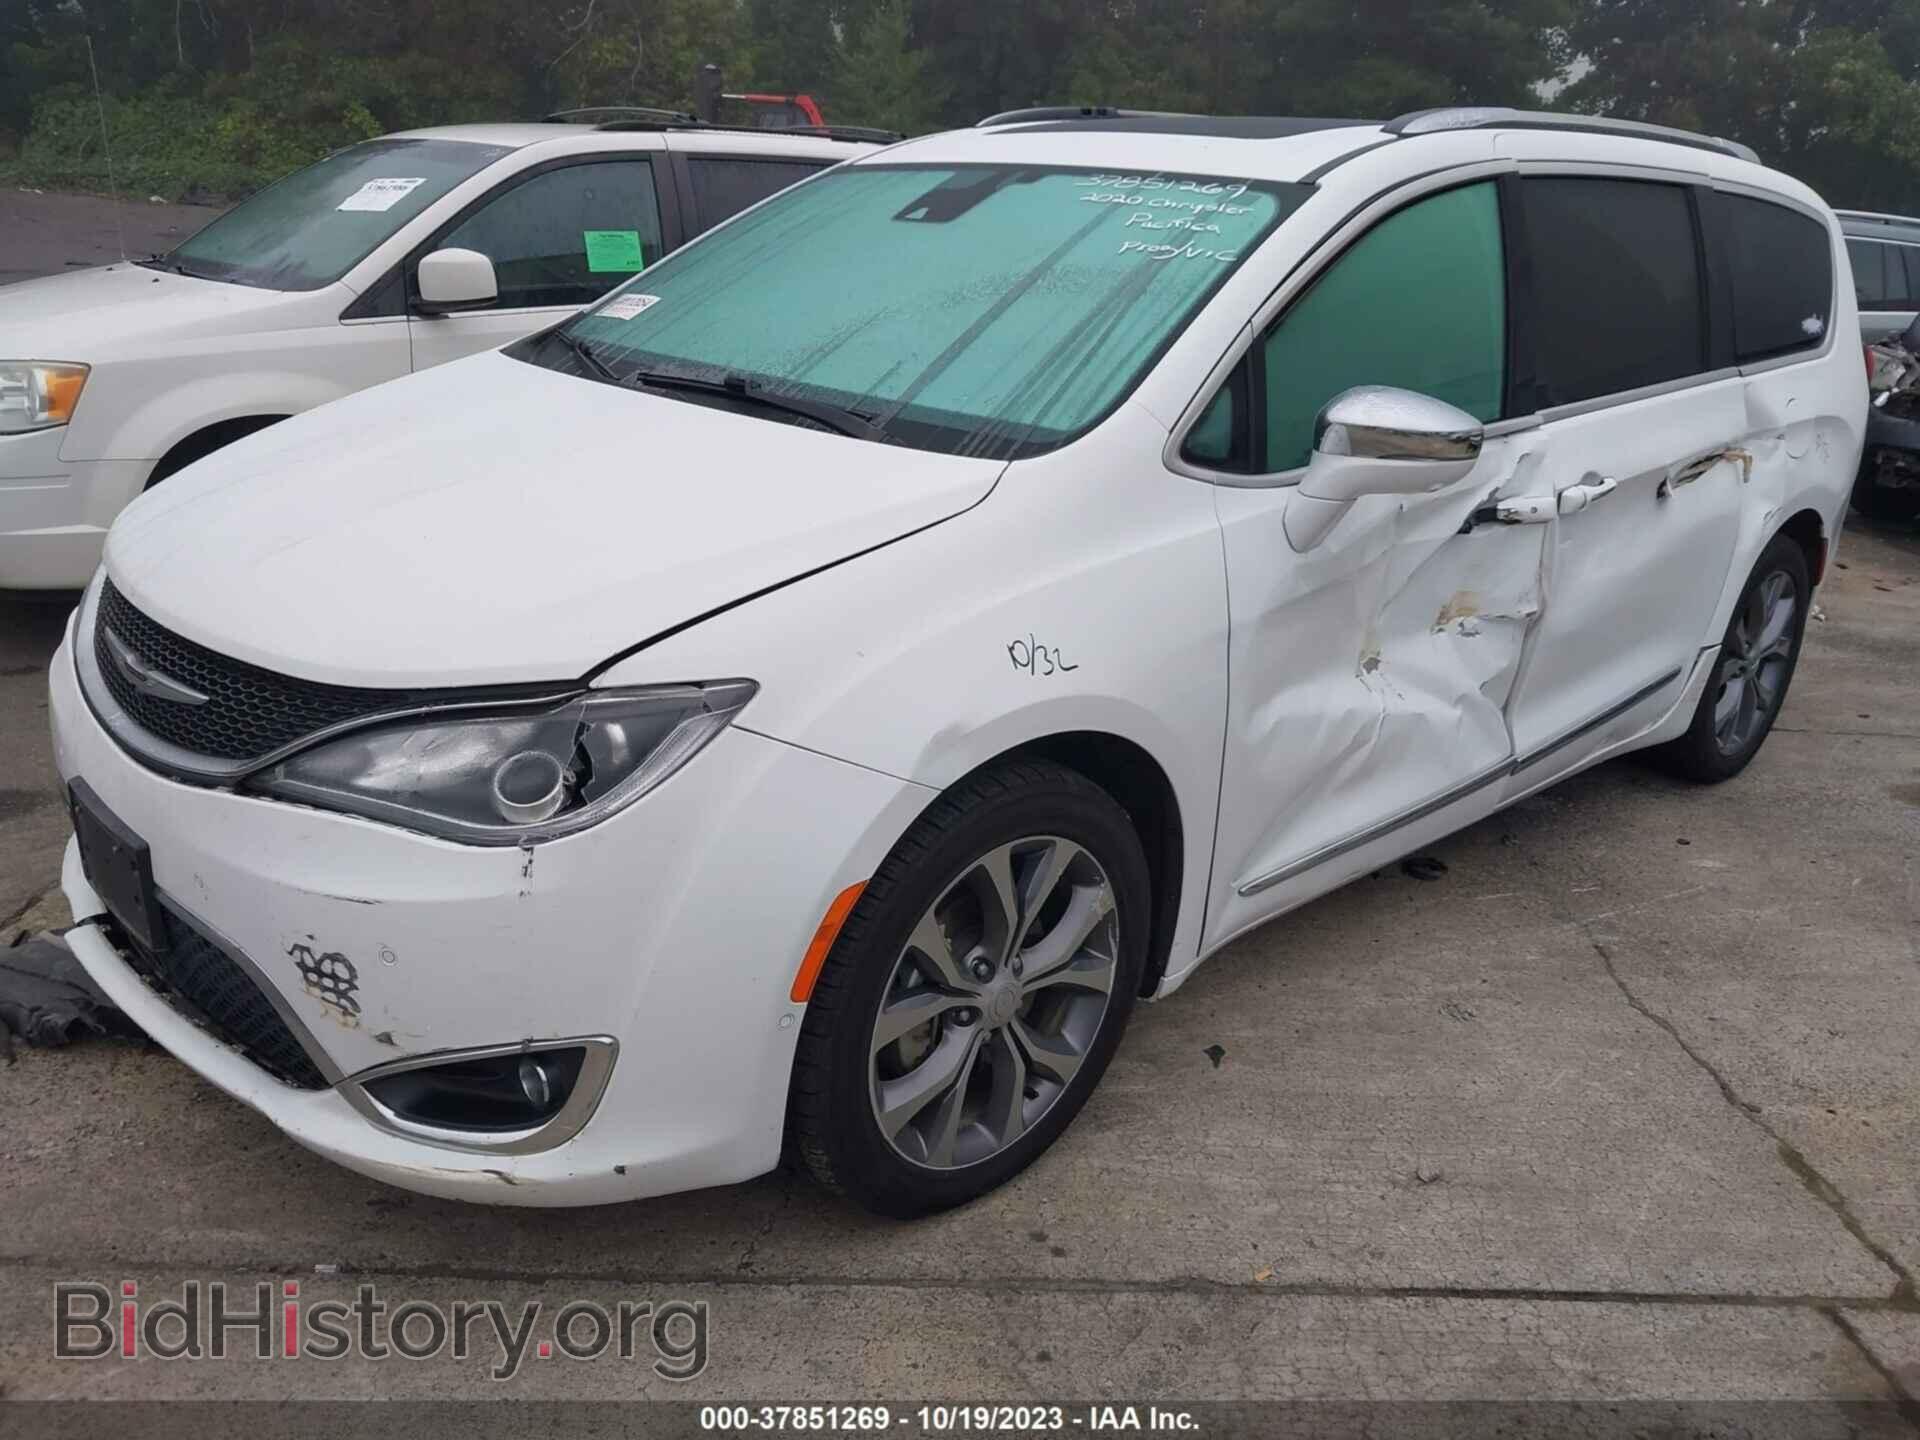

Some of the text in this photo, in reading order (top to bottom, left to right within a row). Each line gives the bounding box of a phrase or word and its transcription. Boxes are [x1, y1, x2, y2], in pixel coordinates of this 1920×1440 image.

[1074, 174, 1248, 199] 37851269
[1080, 192, 1255, 214] 2020 Chrysler
